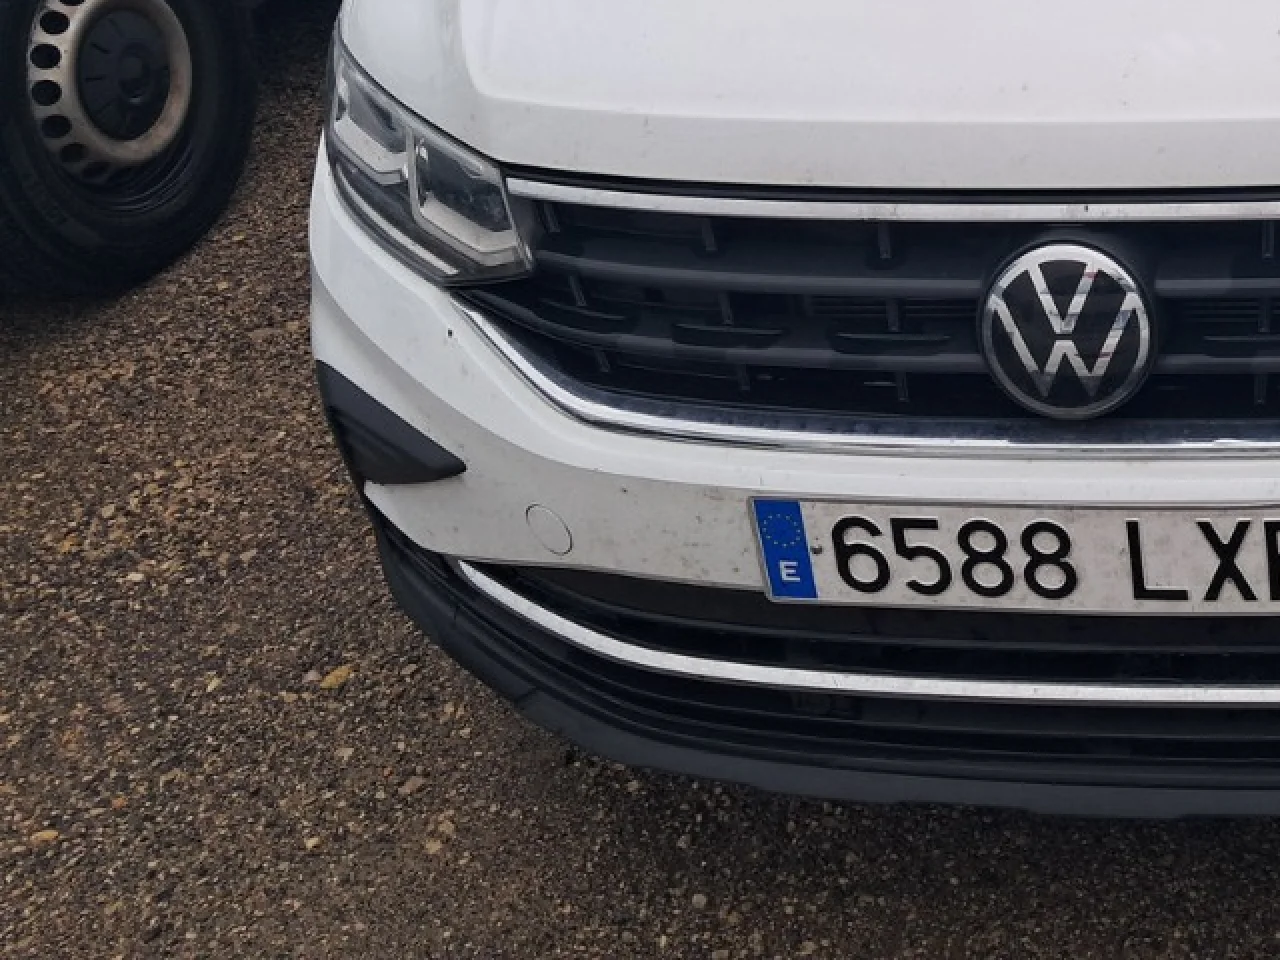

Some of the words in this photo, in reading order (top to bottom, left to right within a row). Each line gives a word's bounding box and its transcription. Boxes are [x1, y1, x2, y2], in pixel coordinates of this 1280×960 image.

[985, 245, 1148, 406] VW
[780, 561, 800, 581] E
[830, 515, 1078, 599] 6588
